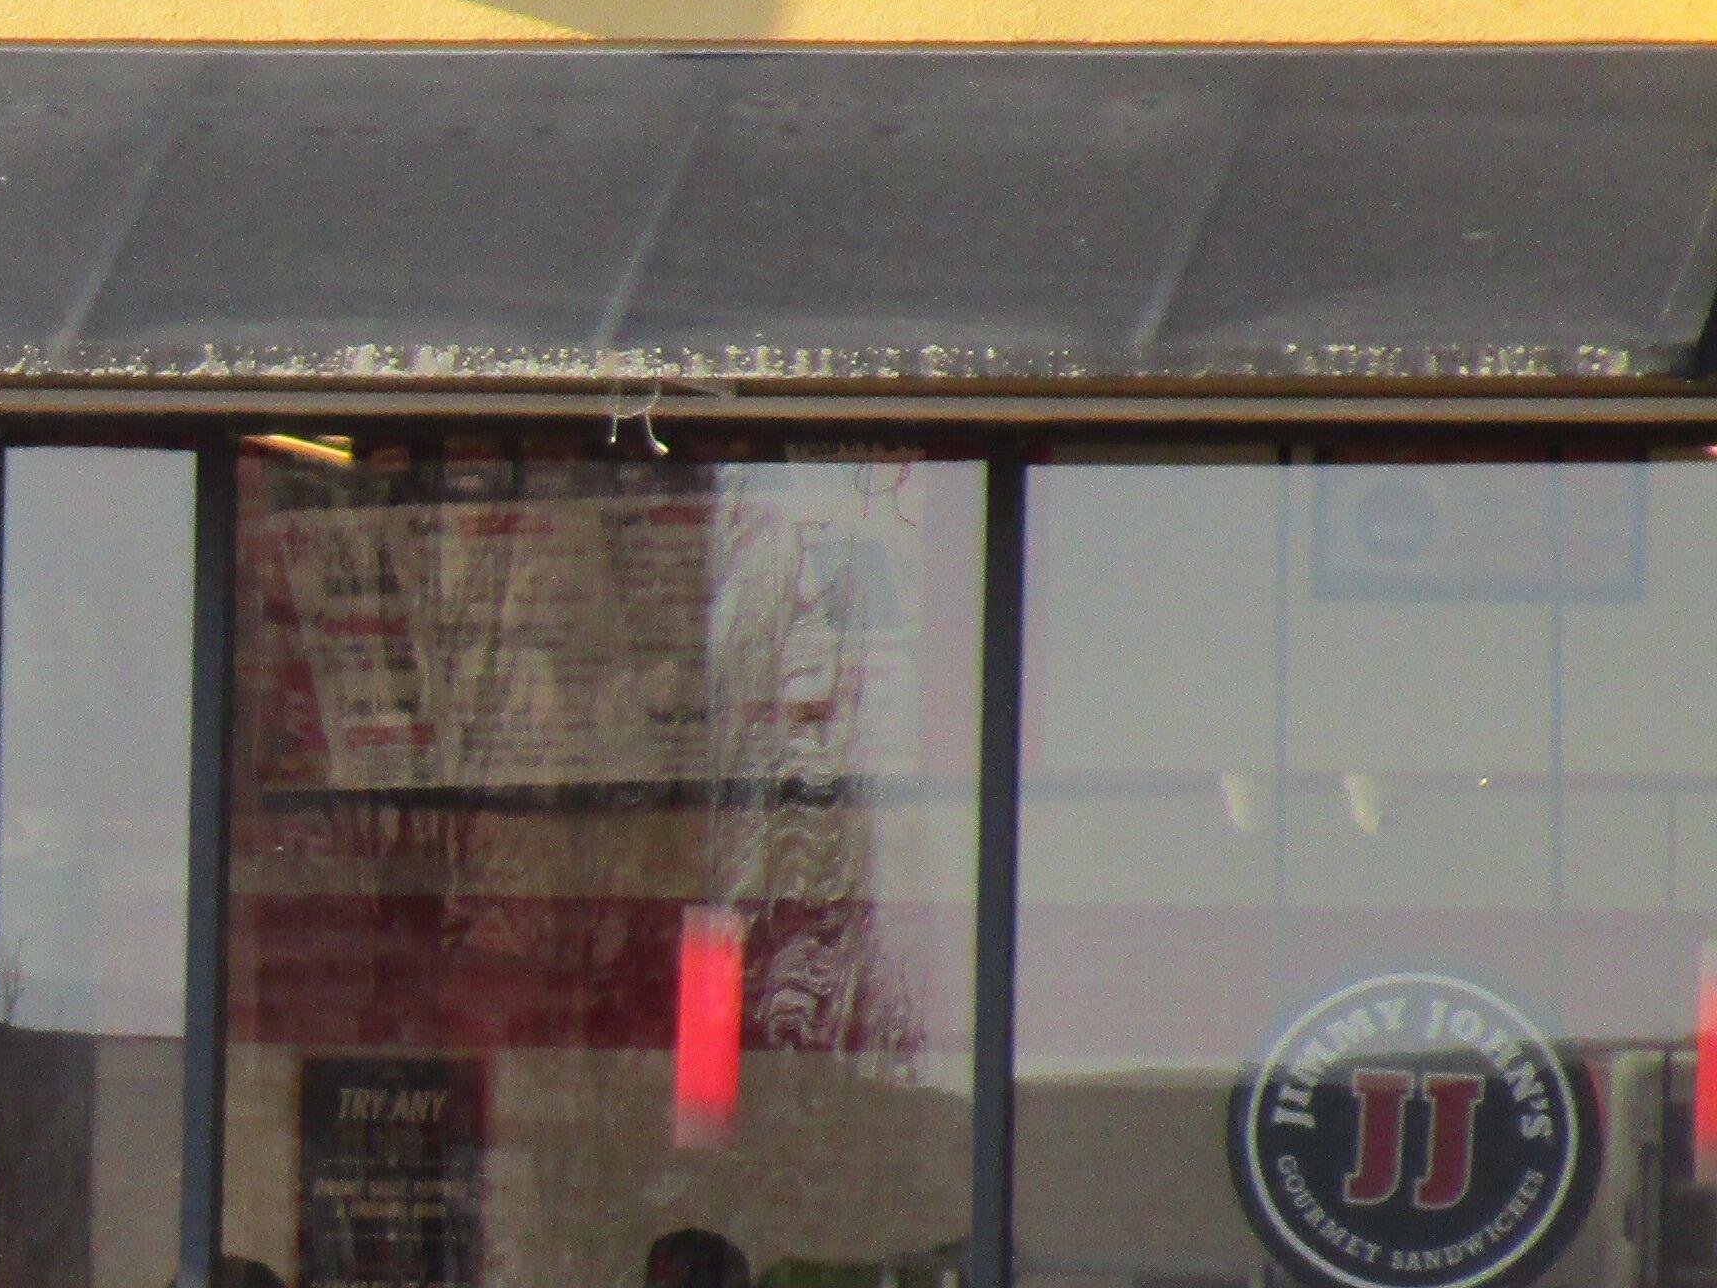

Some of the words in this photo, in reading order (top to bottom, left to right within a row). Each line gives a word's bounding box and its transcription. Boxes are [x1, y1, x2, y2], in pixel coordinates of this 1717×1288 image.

[1274, 997, 1407, 1128] JIMMY
[1344, 1067, 1485, 1210] JJ
[1278, 1155, 1383, 1262] GOURMET
[1390, 1167, 1546, 1272] SANDWICHES
